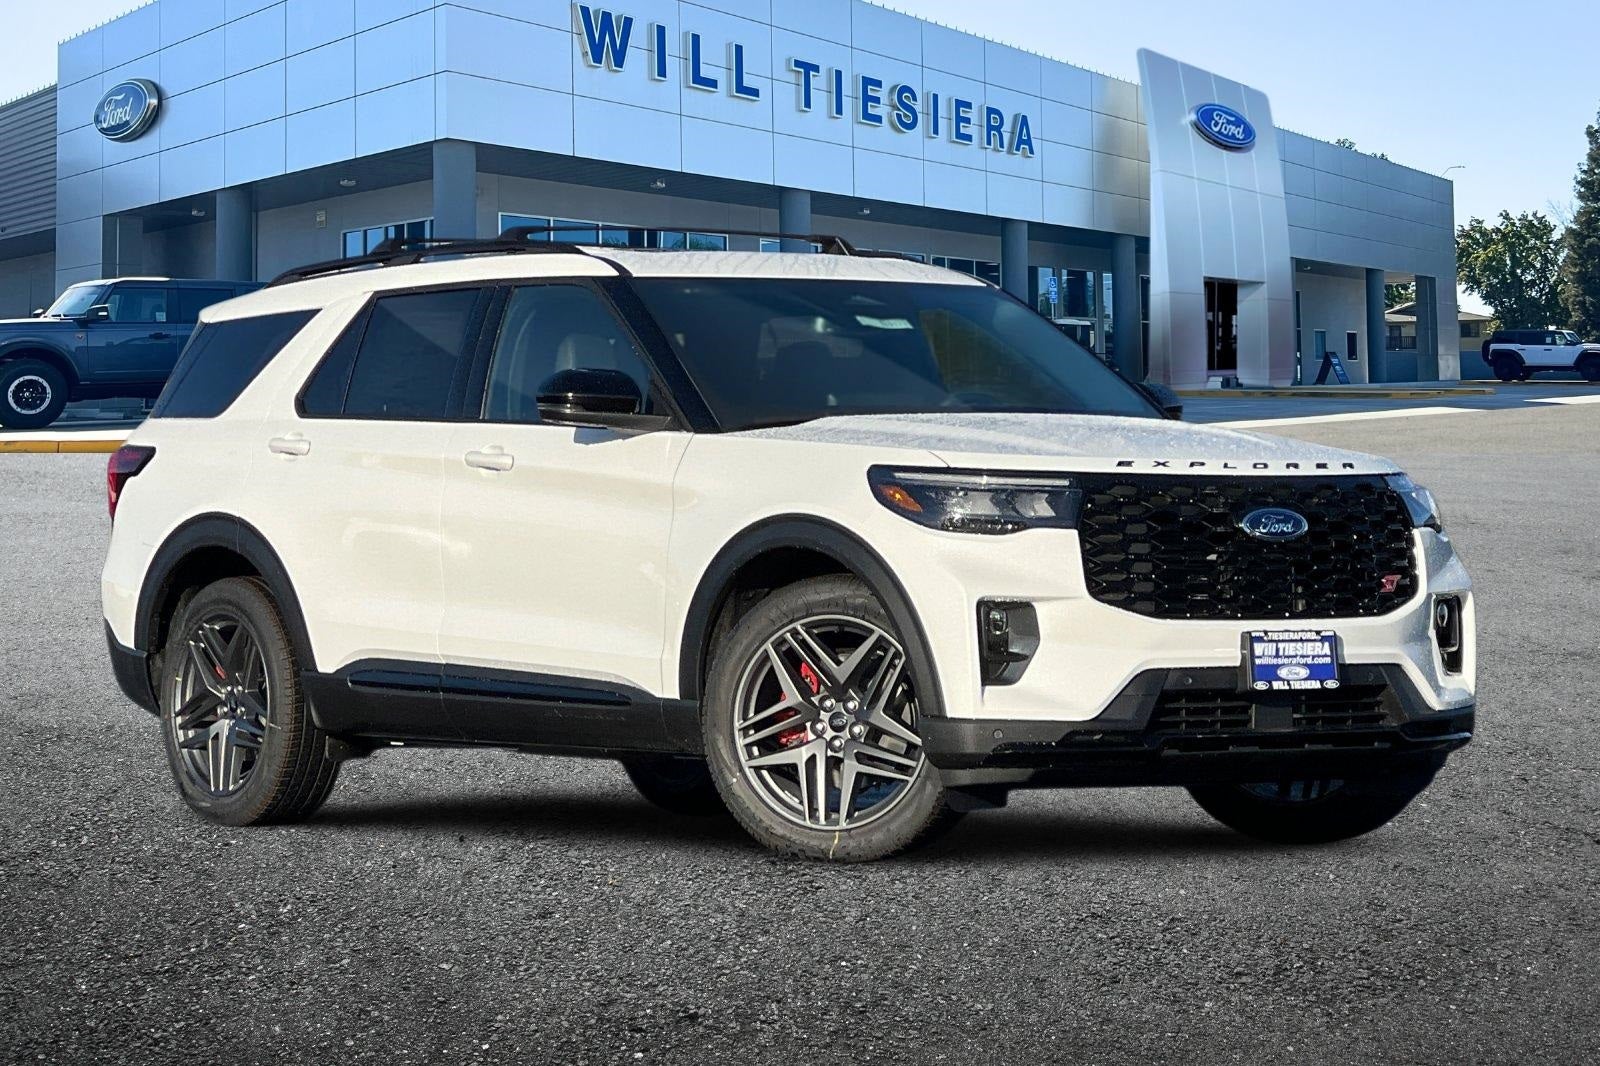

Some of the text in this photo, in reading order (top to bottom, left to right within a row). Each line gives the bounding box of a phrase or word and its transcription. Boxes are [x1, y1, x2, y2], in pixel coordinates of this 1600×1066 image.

[574, 3, 1036, 157] WILL TIESIERA
[102, 93, 133, 128] Ford
[1211, 110, 1245, 139] Ford
[1116, 460, 1354, 470] EXPLORER
[1259, 514, 1295, 533] Ford
[1278, 641, 1331, 656] TIESIERA
[1255, 656, 1332, 664] willtiesieraford.com
[1272, 681, 1289, 690] WILL
[1290, 680, 1322, 689] TIESIERA
